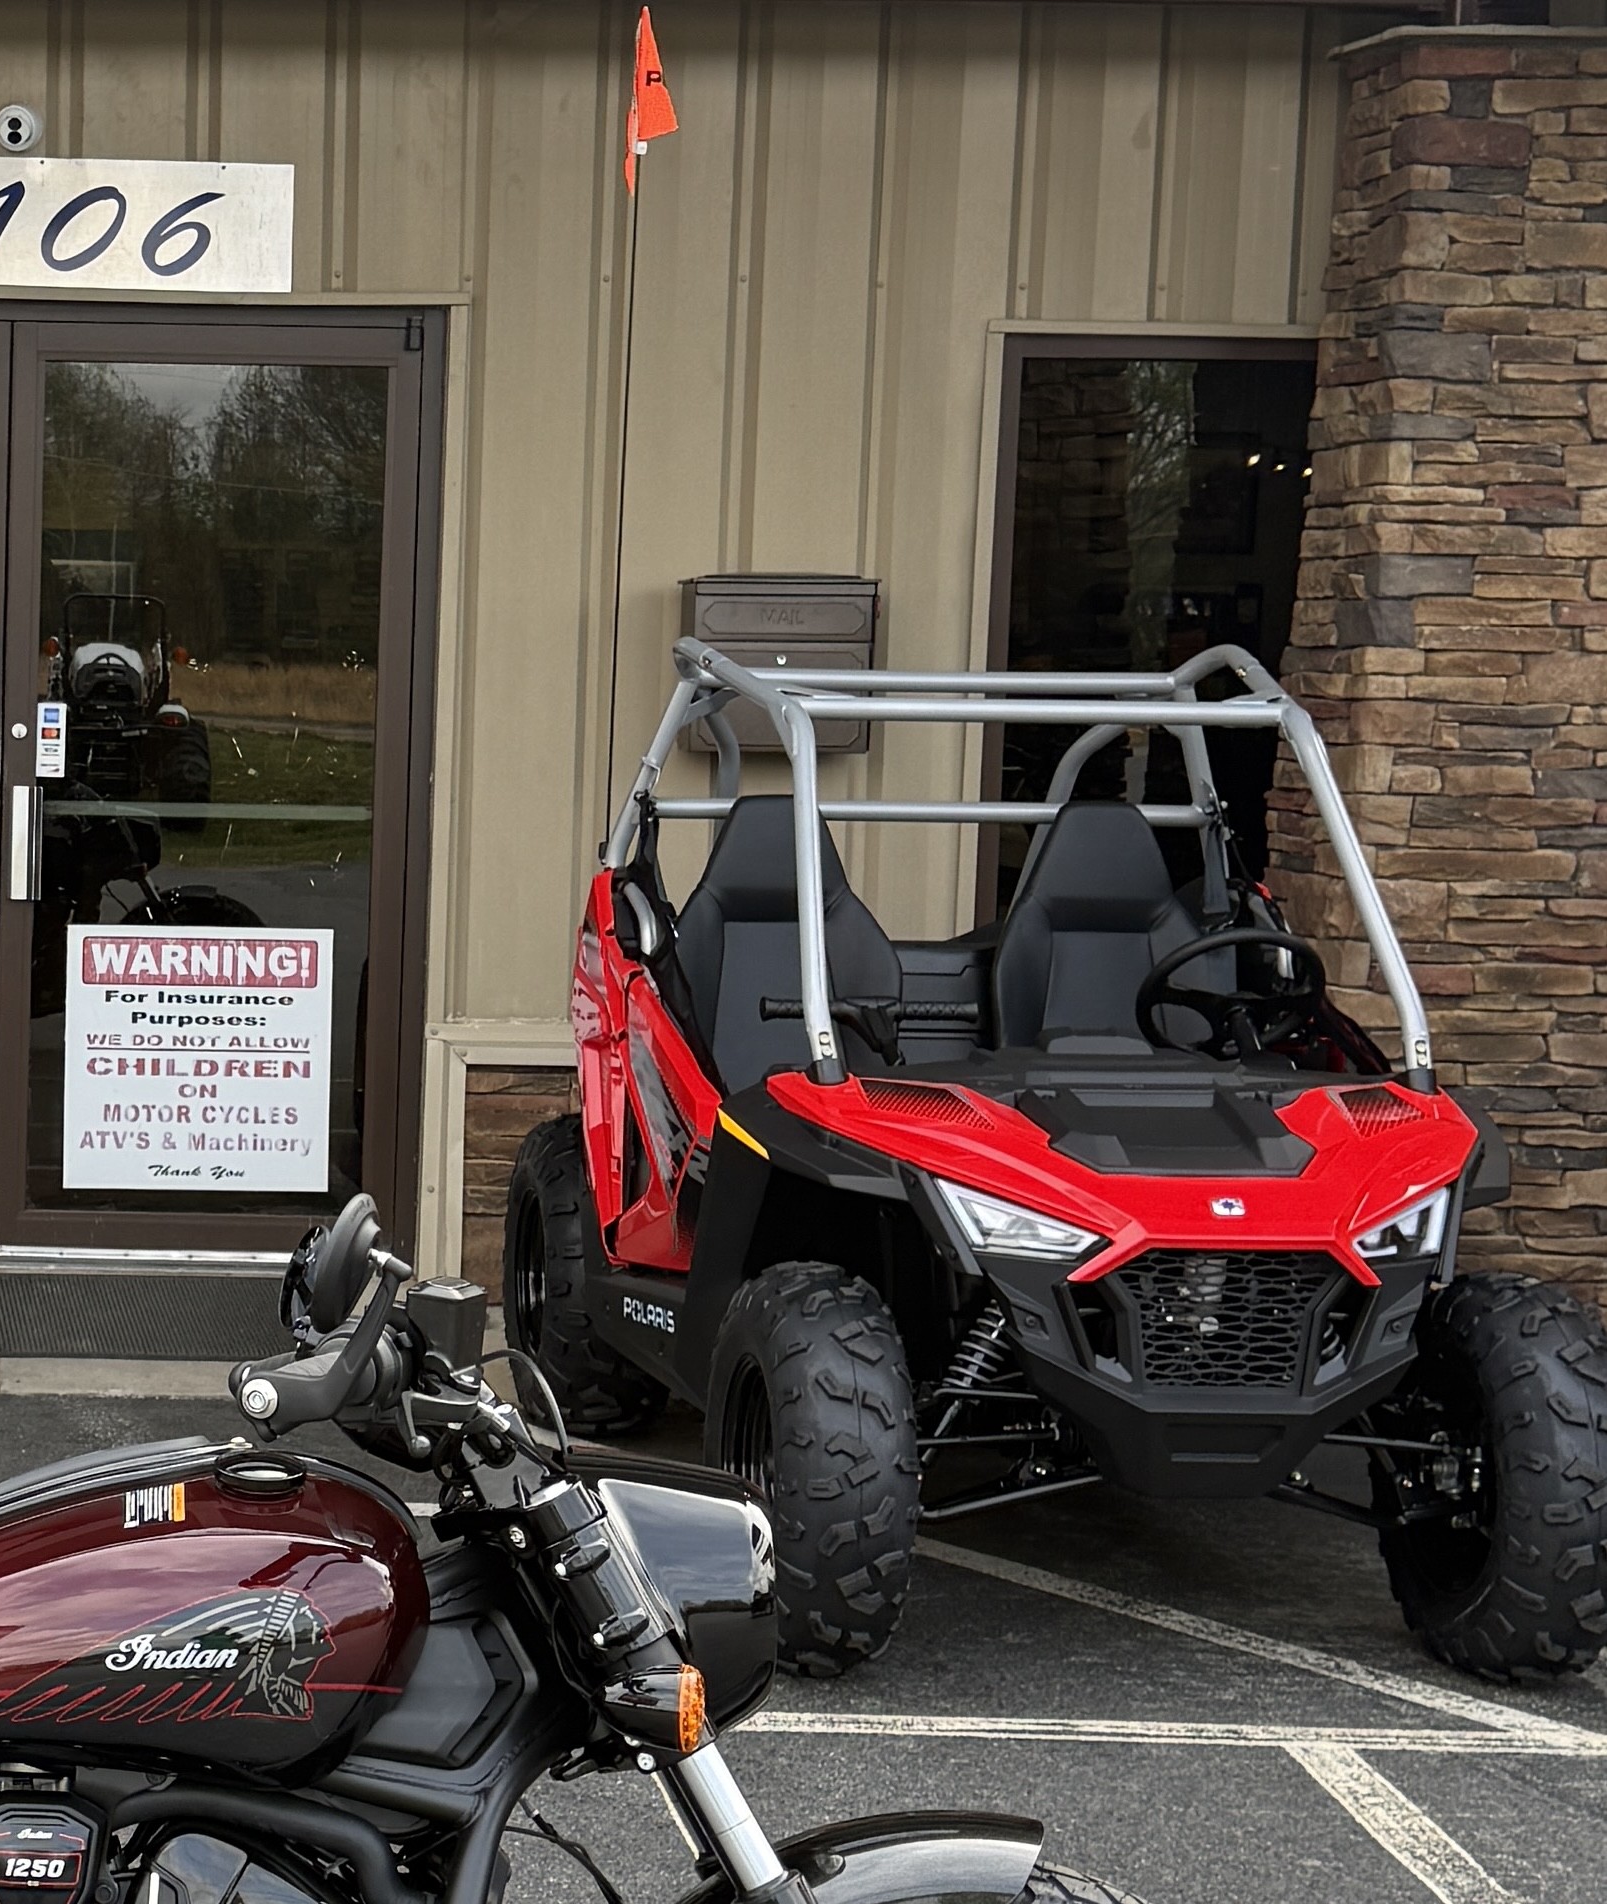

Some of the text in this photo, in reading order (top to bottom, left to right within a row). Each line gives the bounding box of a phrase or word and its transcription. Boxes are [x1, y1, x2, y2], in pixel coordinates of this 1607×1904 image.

[759, 607, 805, 625] MAIL
[90, 942, 311, 980] WARNING!
[104, 989, 295, 1006] For Insurance
[131, 1011, 267, 1028] Purposes:
[86, 1033, 311, 1049] WE DO NOT ALLOW
[86, 1057, 312, 1079] CHILDREN
[178, 1083, 218, 1099] ON
[103, 1104, 299, 1125] MOTOR CYCLES
[79, 1131, 313, 1157] ATV'S & Machinery
[147, 1164, 246, 1180] Thank You
[623, 1296, 675, 1333] POLARIS
[104, 1633, 240, 1672] Indian
[5, 1858, 65, 1878] 1250
